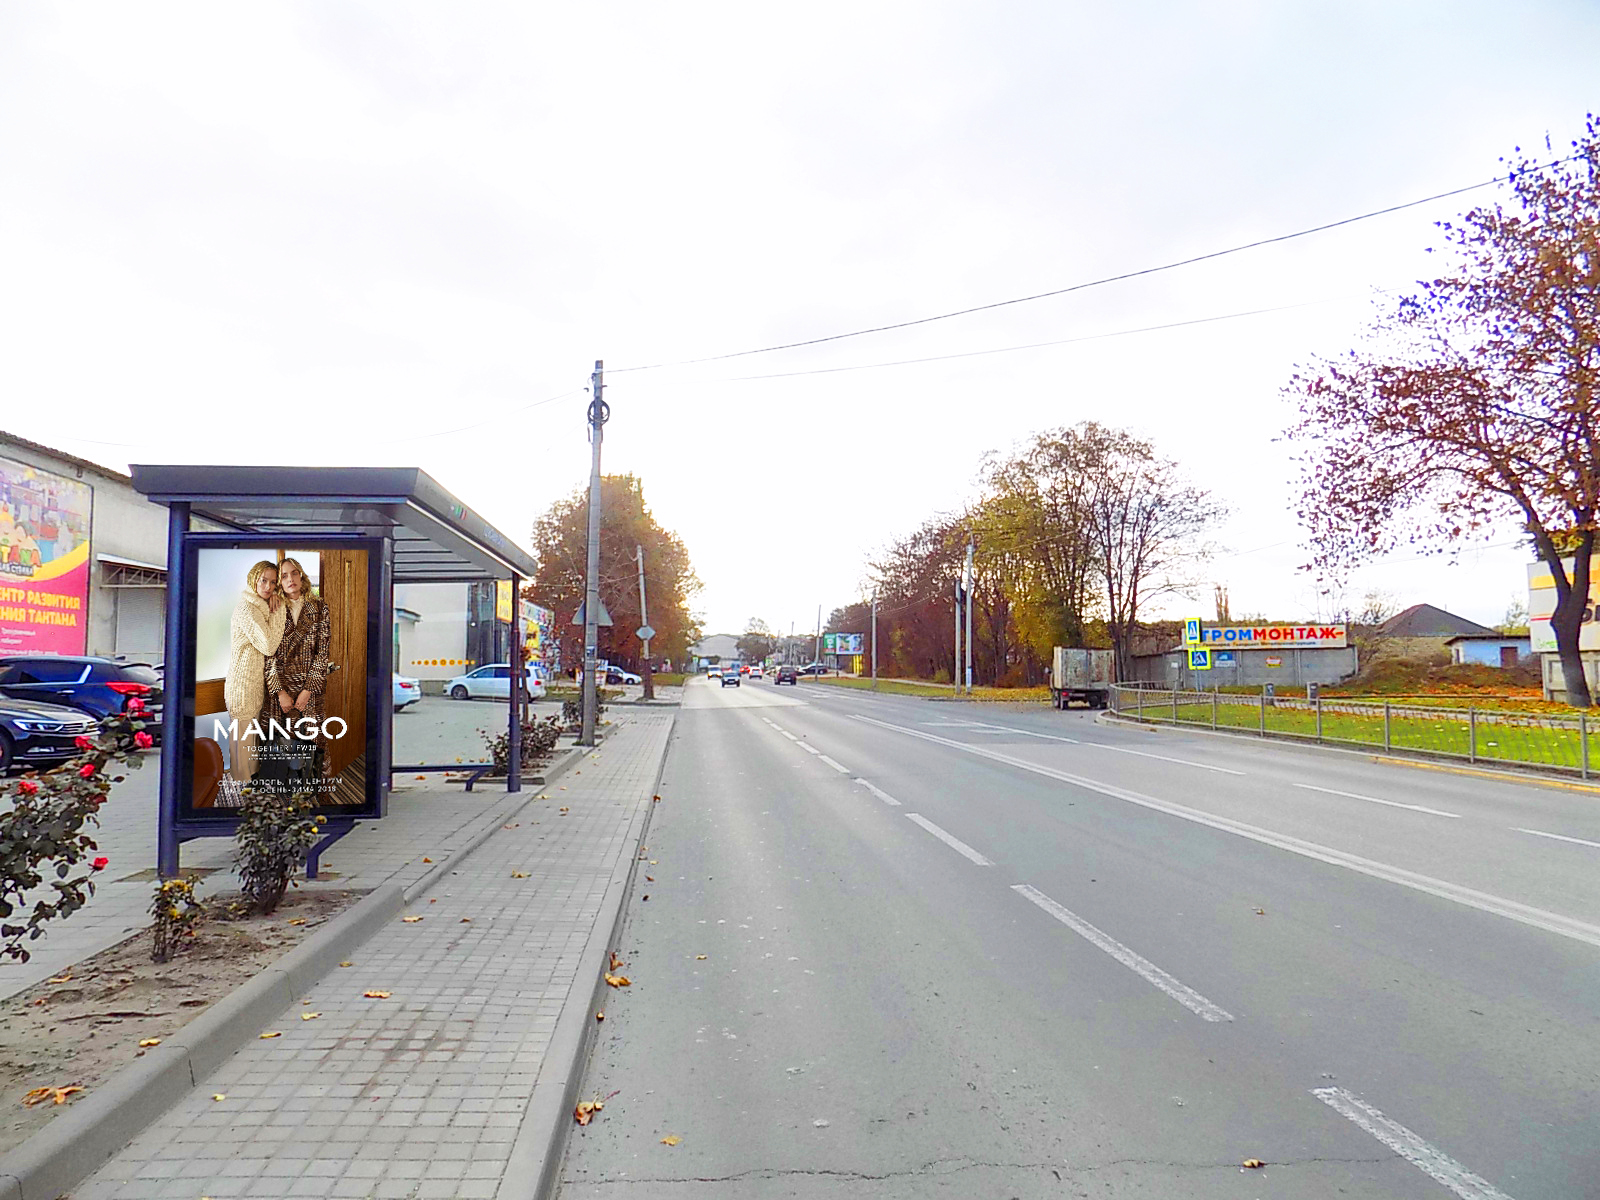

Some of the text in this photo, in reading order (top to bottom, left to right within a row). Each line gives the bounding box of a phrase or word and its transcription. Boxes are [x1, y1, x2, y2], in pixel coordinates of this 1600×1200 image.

[27, 590, 81, 610] РАЗВИТИЯ
[0, 606, 77, 626] НИЯ ТАНТАНА
[213, 716, 348, 741] MANGO
[317, 785, 337, 793] 2018
